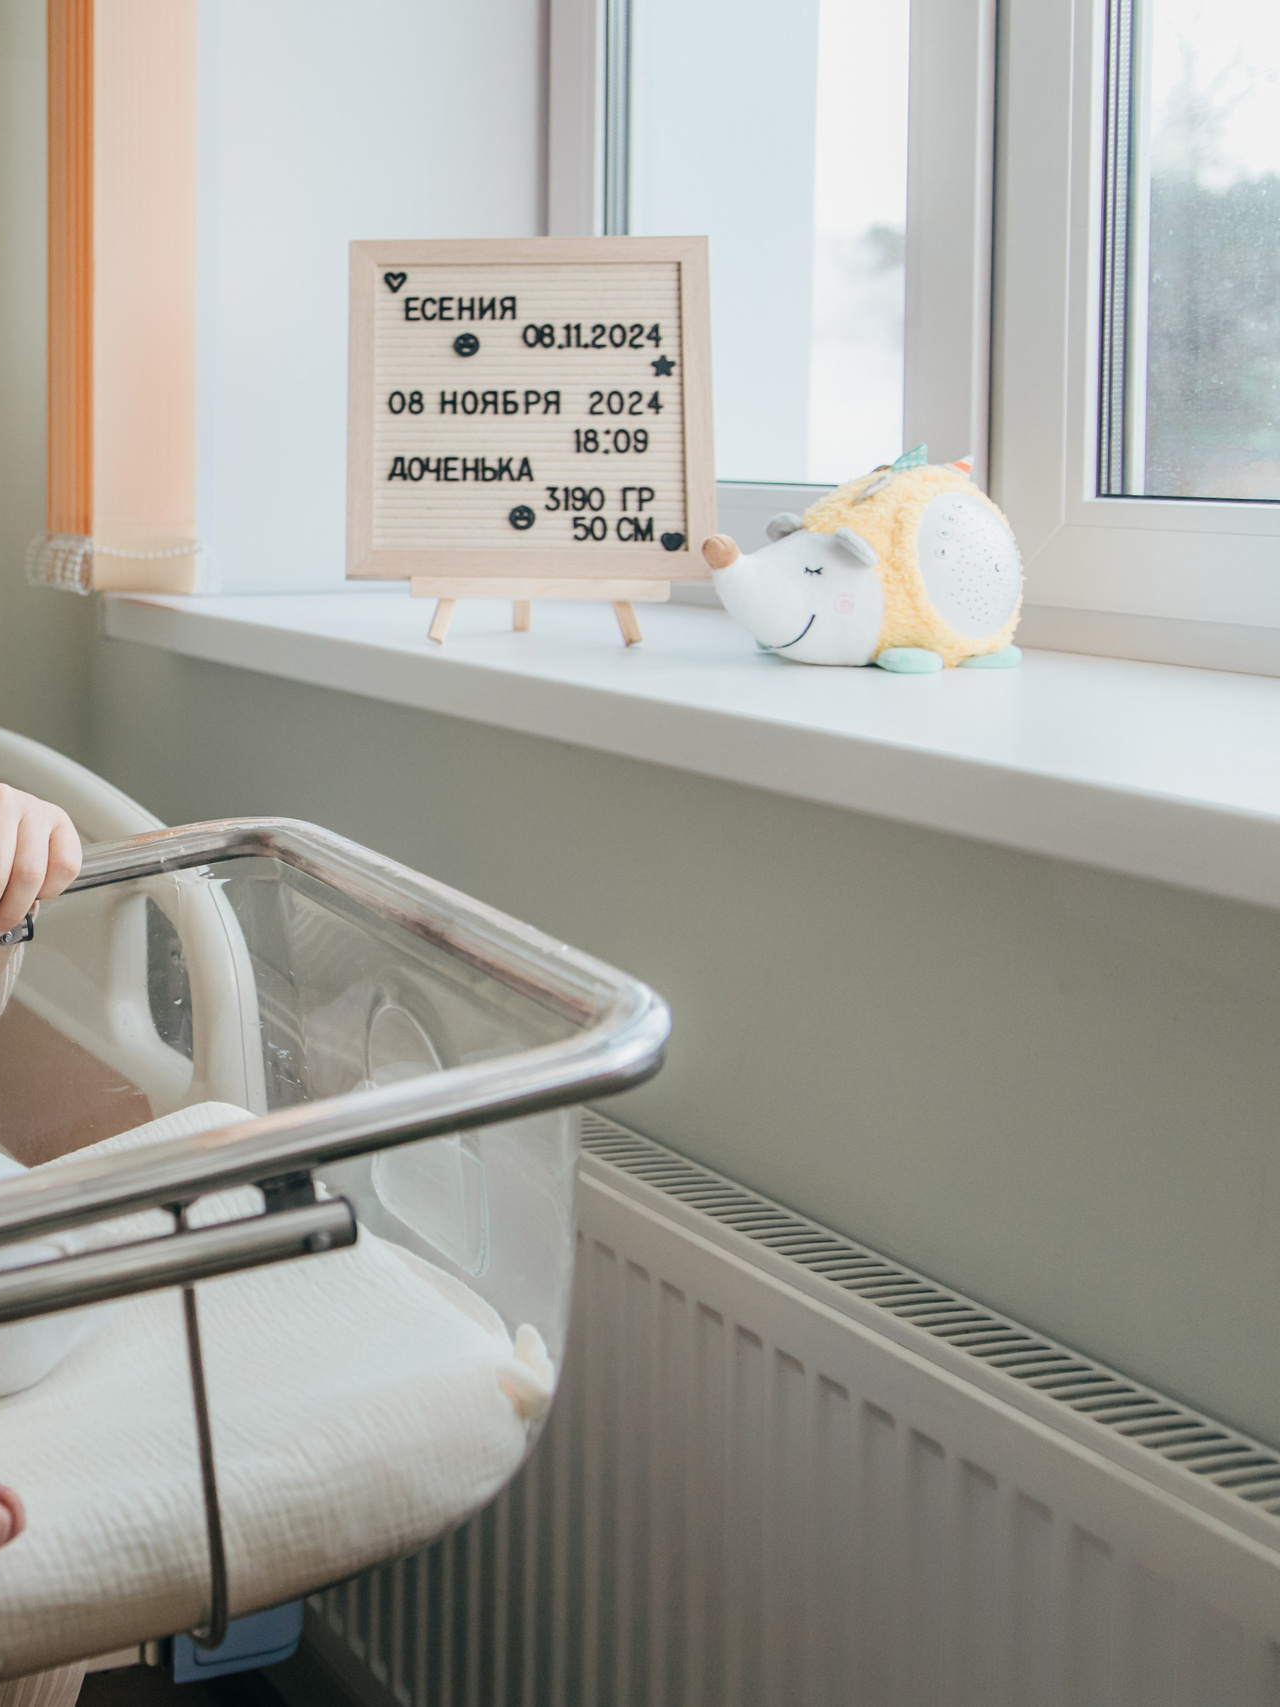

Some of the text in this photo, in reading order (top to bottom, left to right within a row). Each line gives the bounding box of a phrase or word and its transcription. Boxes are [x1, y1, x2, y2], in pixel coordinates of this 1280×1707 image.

[403, 295, 517, 322] ЕСЕНИЯ
[521, 323, 662, 350] 08.11.2024
[387, 389, 664, 416] 08 НОЯБРЯ 2024
[574, 428, 649, 455] 18:09
[387, 456, 534, 483] ДОЧЕНЬКА
[544, 486, 655, 512] 3190 ГР
[572, 515, 655, 542] 50 СМ
